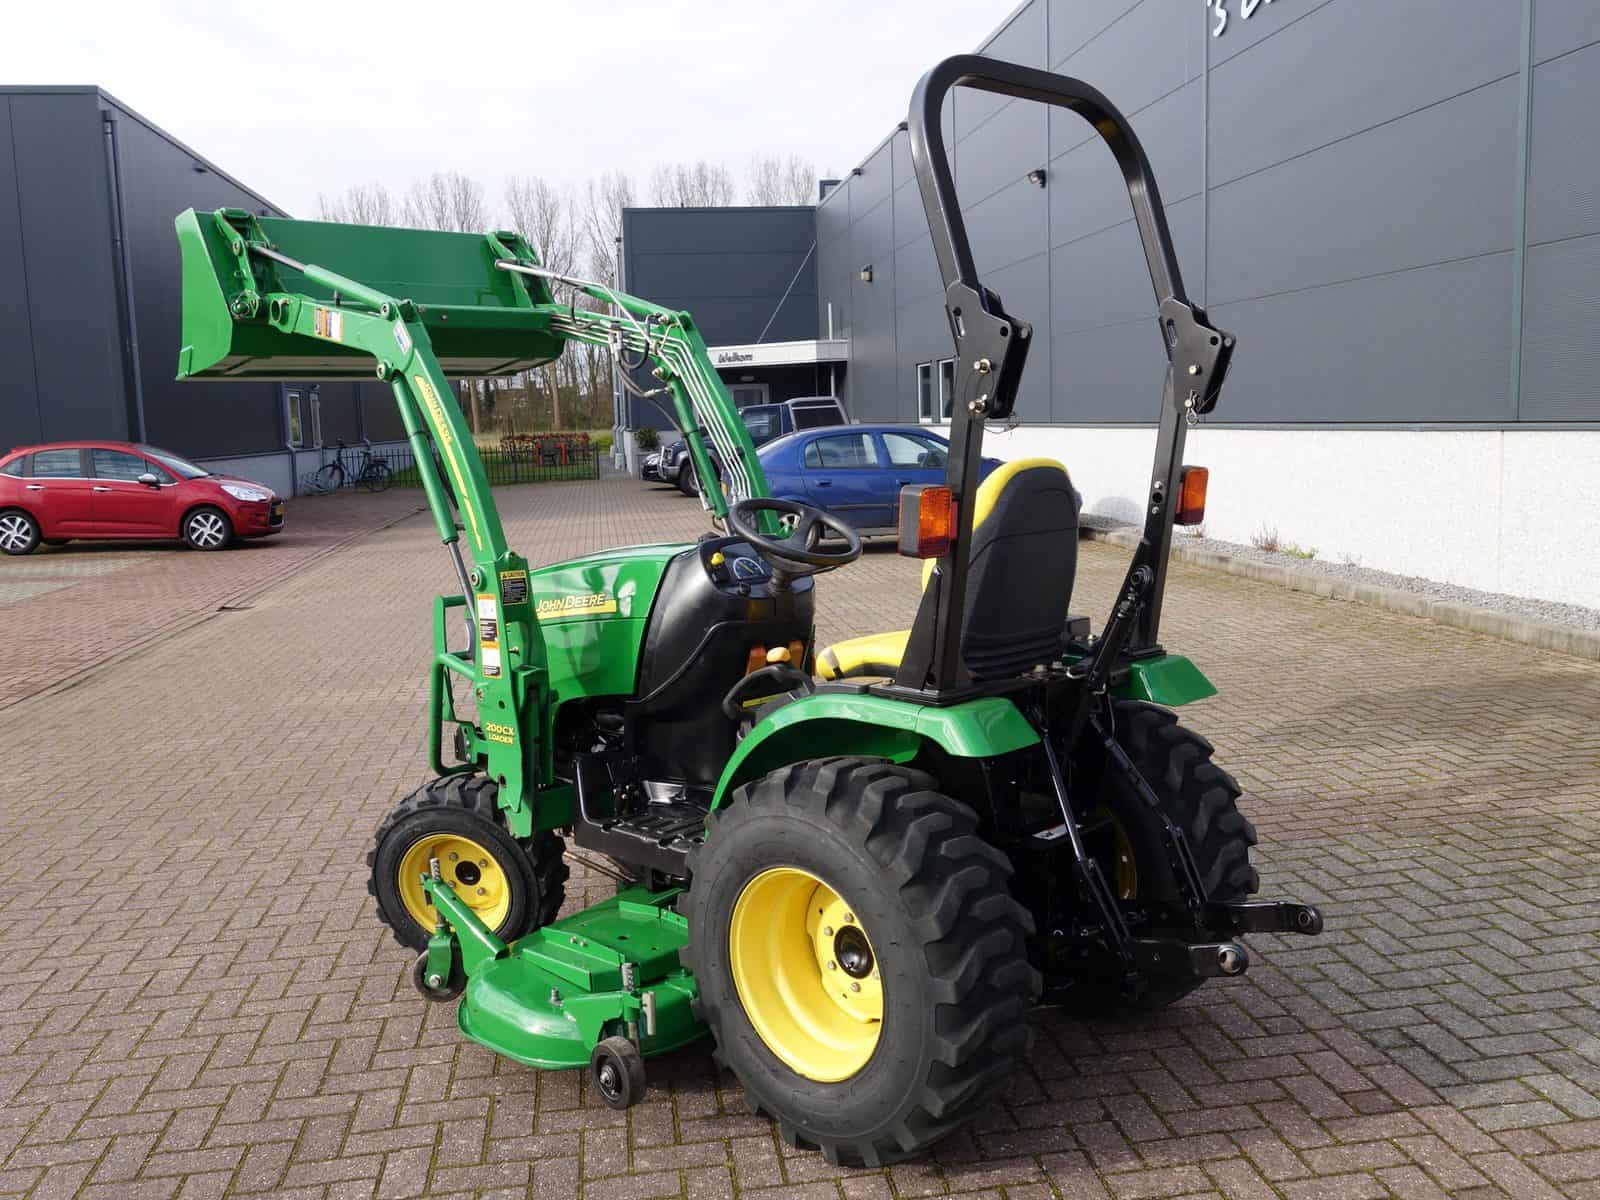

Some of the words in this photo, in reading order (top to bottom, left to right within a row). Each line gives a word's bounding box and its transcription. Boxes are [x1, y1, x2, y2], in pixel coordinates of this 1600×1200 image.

[535, 599, 565, 613] JOHN
[564, 593, 607, 610] DEERE
[485, 722, 514, 736] 200CX
[488, 732, 514, 745] LOADER
